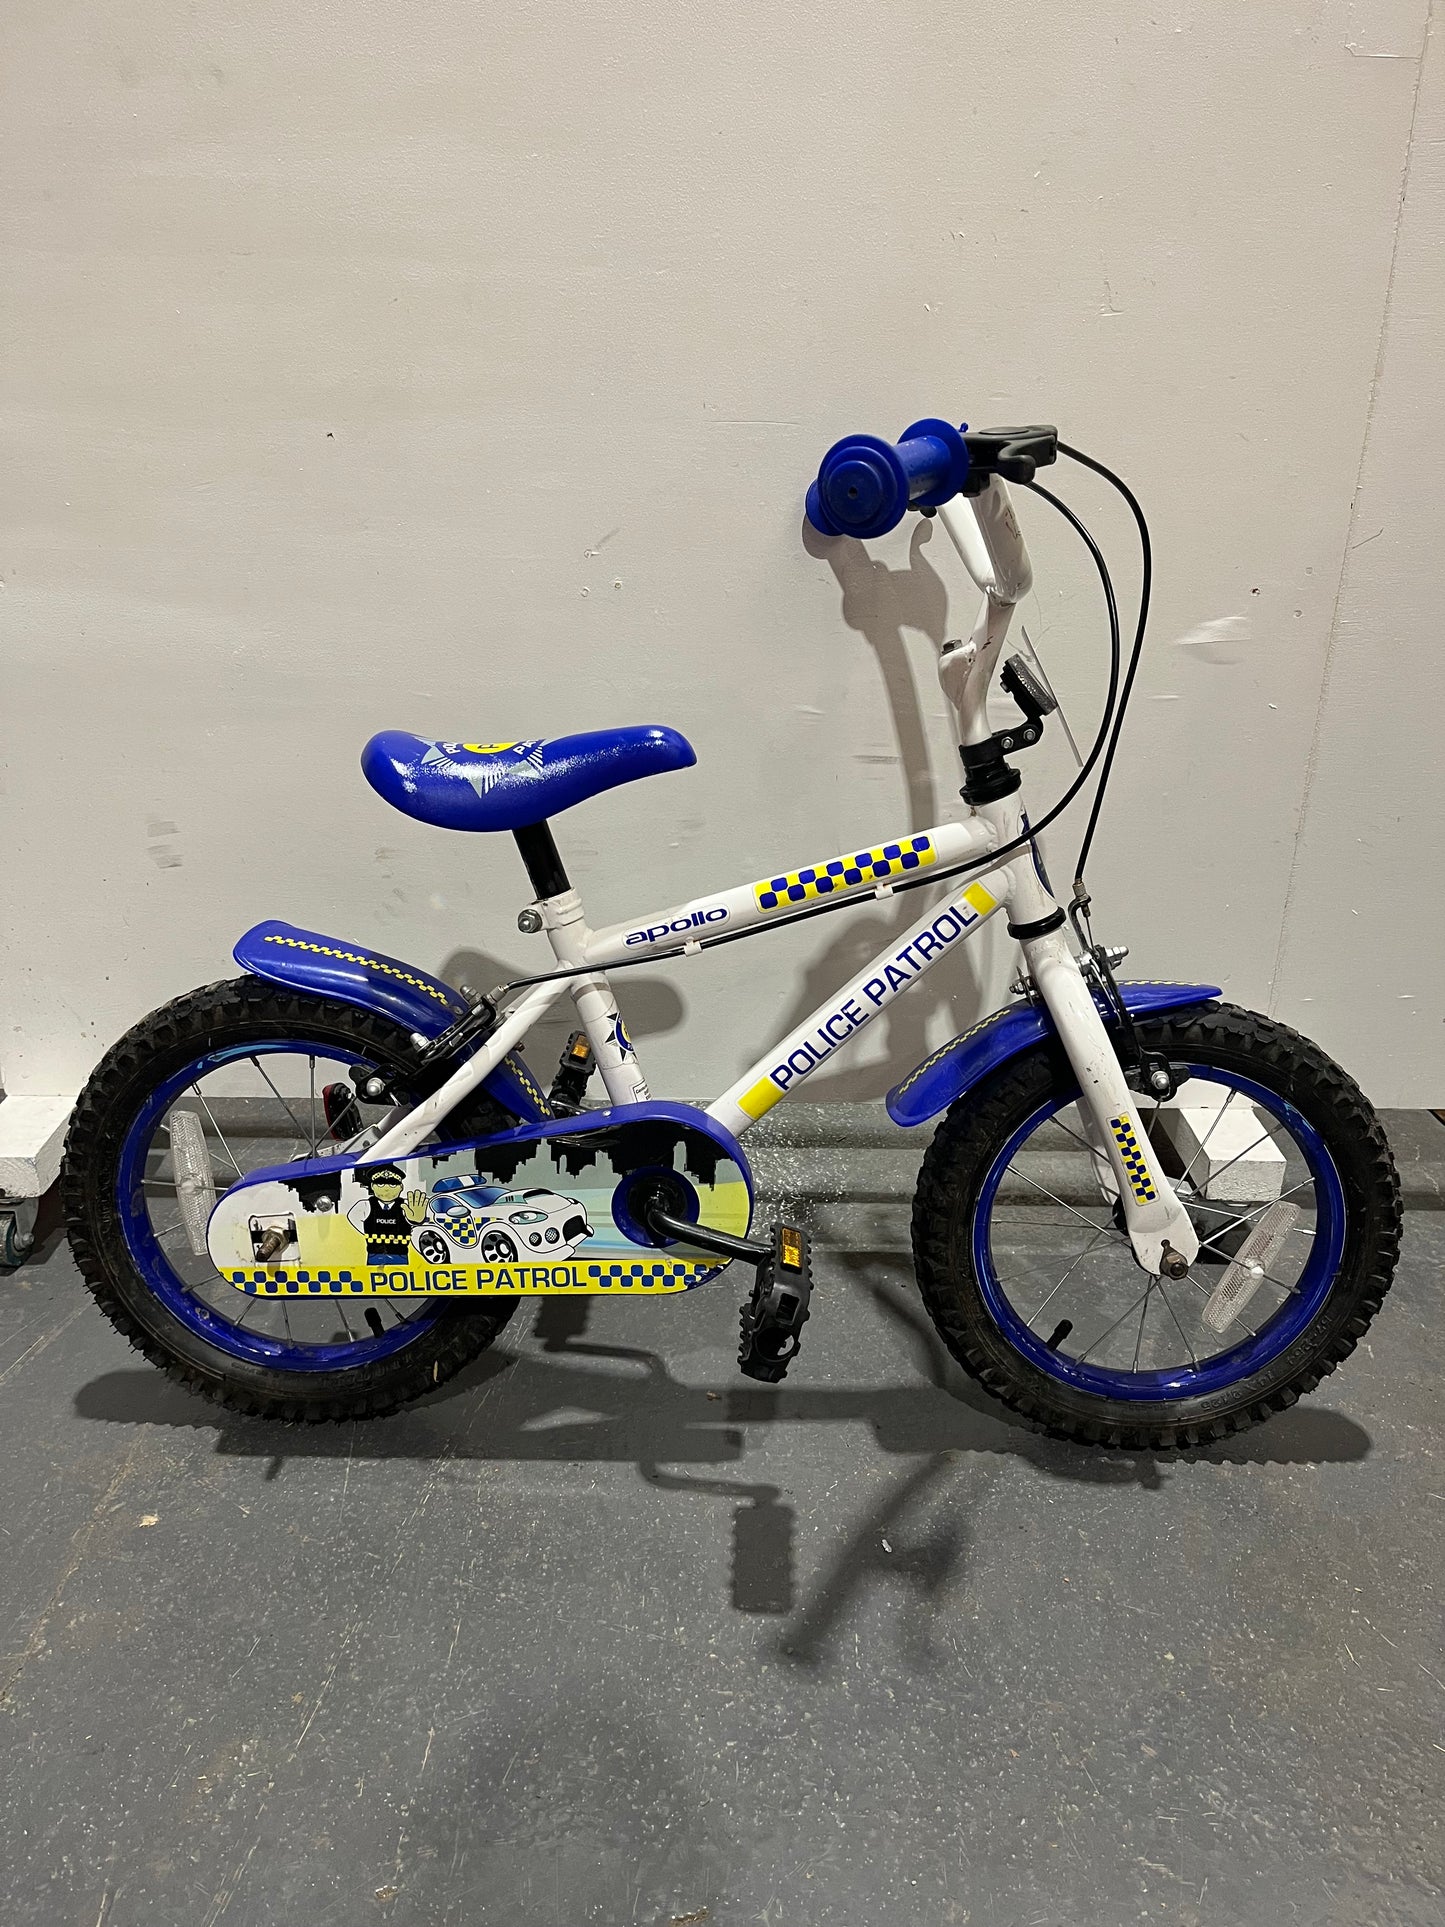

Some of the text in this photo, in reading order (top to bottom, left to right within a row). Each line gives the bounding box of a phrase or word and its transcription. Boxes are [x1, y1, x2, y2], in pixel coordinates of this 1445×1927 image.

[626, 908, 728, 946] apollo
[770, 906, 979, 1091] POLICE PATROL
[370, 1266, 587, 1292] POLICE PATROL
